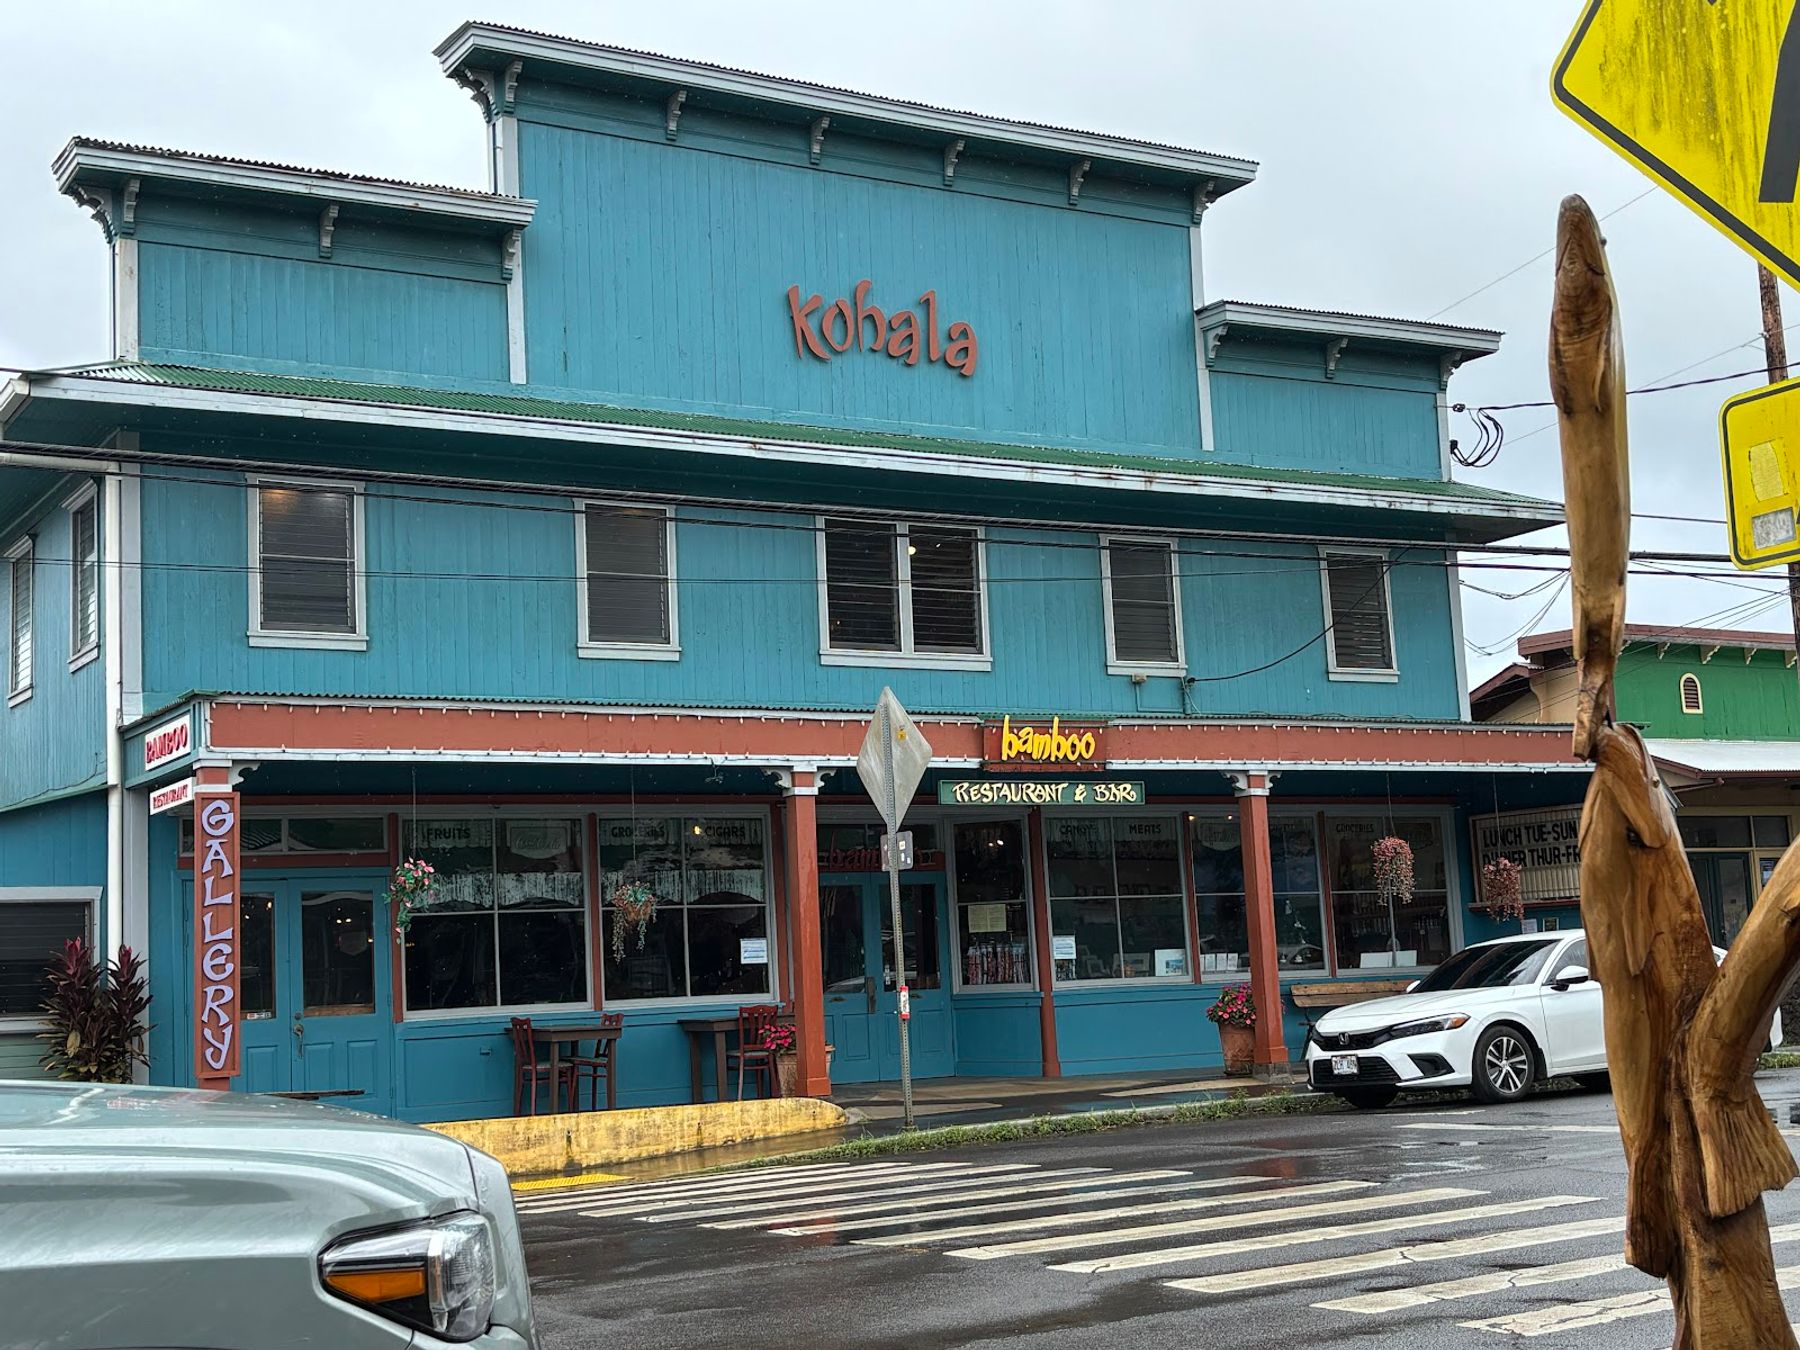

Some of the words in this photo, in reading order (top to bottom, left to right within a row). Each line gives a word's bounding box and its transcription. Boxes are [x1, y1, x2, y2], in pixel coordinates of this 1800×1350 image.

[146, 724, 187, 763] BAMBOO
[1002, 714, 1096, 762] bamboo
[153, 784, 188, 809] RESTAURANT
[952, 782, 1069, 804] RESTAURANT
[1074, 783, 1087, 804] &
[1093, 783, 1138, 803] BAR
[426, 827, 471, 841] FRUITS
[704, 826, 746, 838] CIGARS
[1128, 823, 1162, 835] MEATS
[1482, 827, 1522, 848] LUNCH
[1525, 820, 1579, 844] TUE-SUN
[1528, 844, 1582, 868] THUR-FR
[201, 799, 235, 1070] GALLERY
